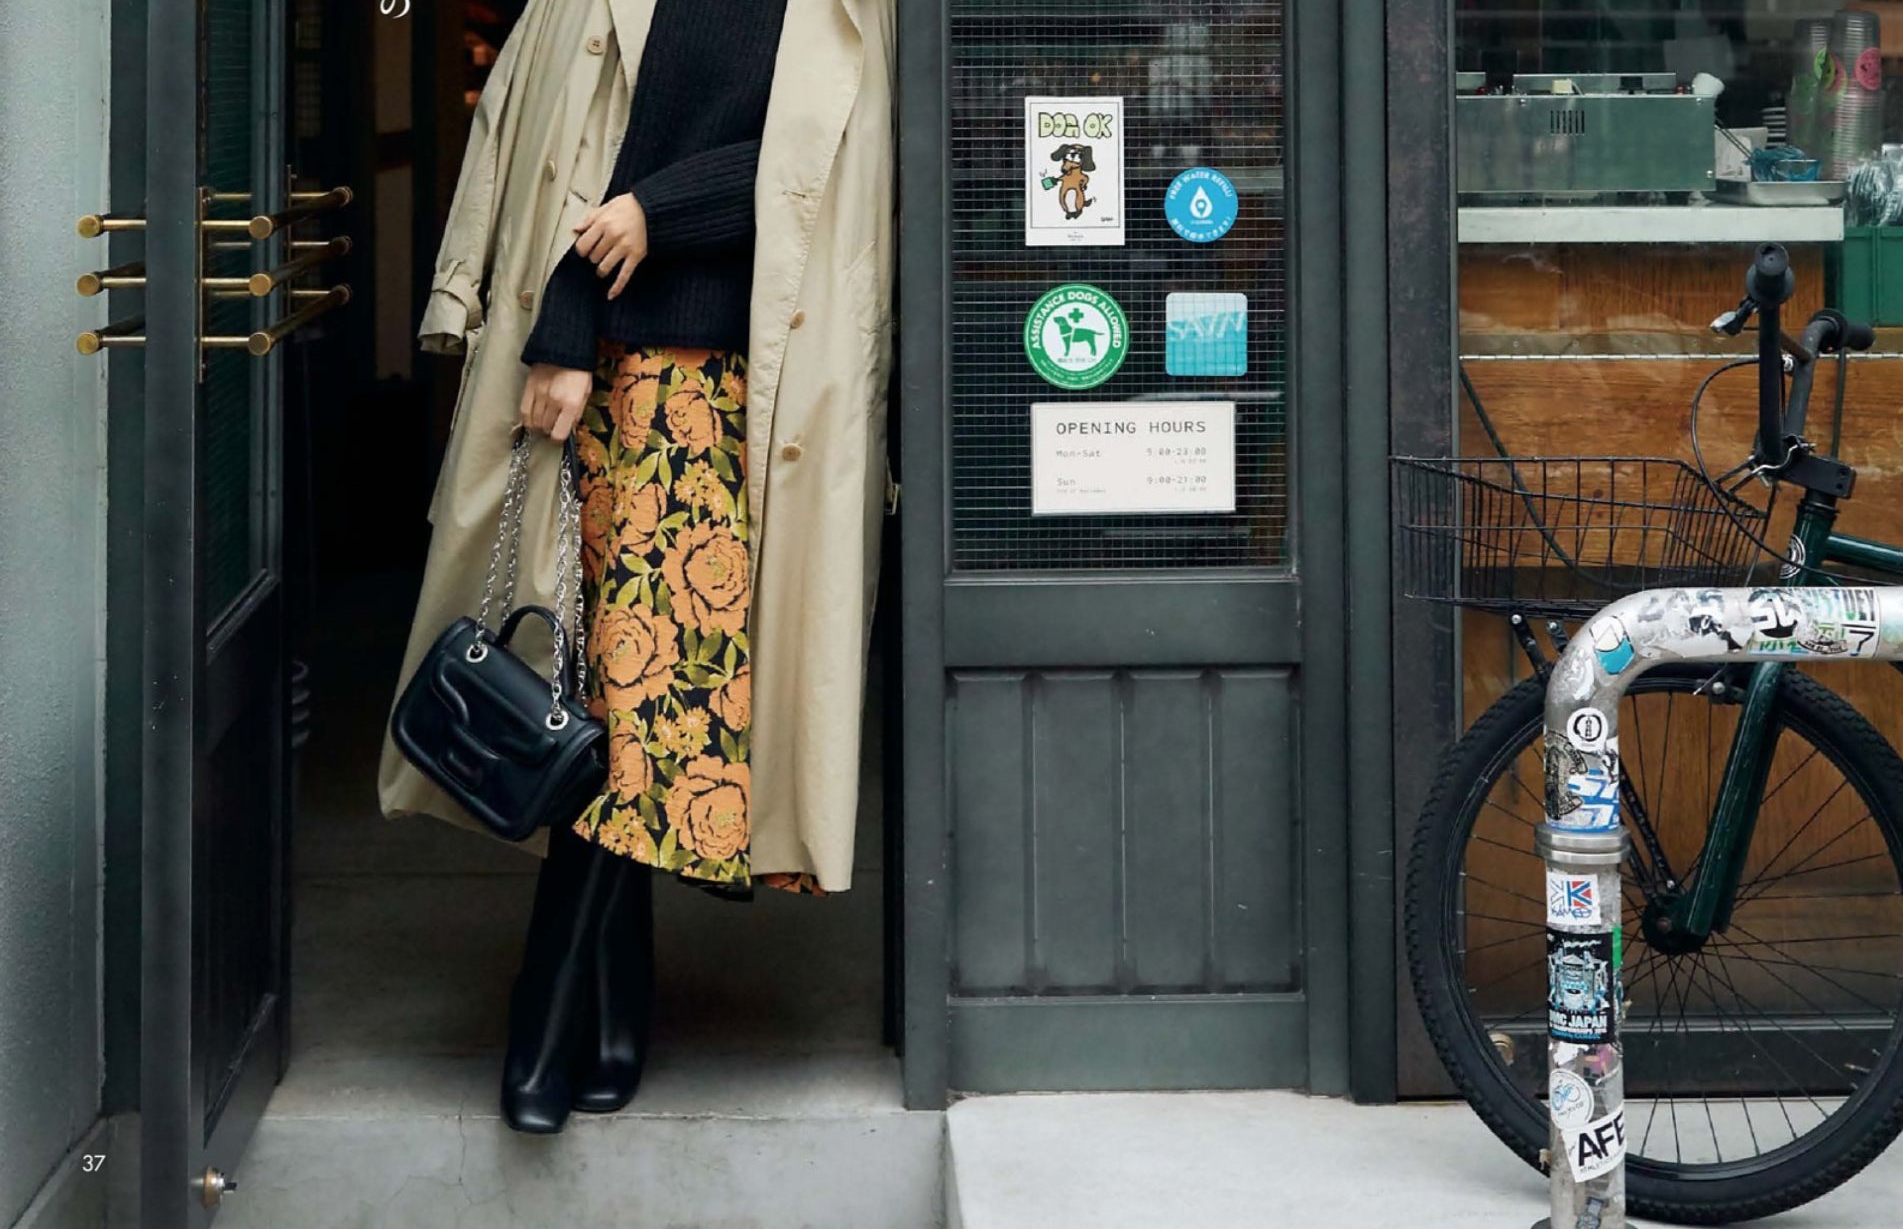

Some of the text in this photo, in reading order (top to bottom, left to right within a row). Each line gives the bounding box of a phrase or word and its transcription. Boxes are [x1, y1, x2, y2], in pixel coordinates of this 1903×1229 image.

[1038, 112, 1113, 139] DOG OK
[1031, 293, 1067, 349] ASSISTANCE
[1067, 291, 1099, 305] DOGS
[1097, 301, 1122, 349] ALLOWED
[1056, 421, 1206, 435] OPENING HOURS
[1056, 449, 1101, 458] Mon-Sat
[1057, 477, 1076, 487] Sun
[1568, 1015, 1608, 1029] JAPAN
